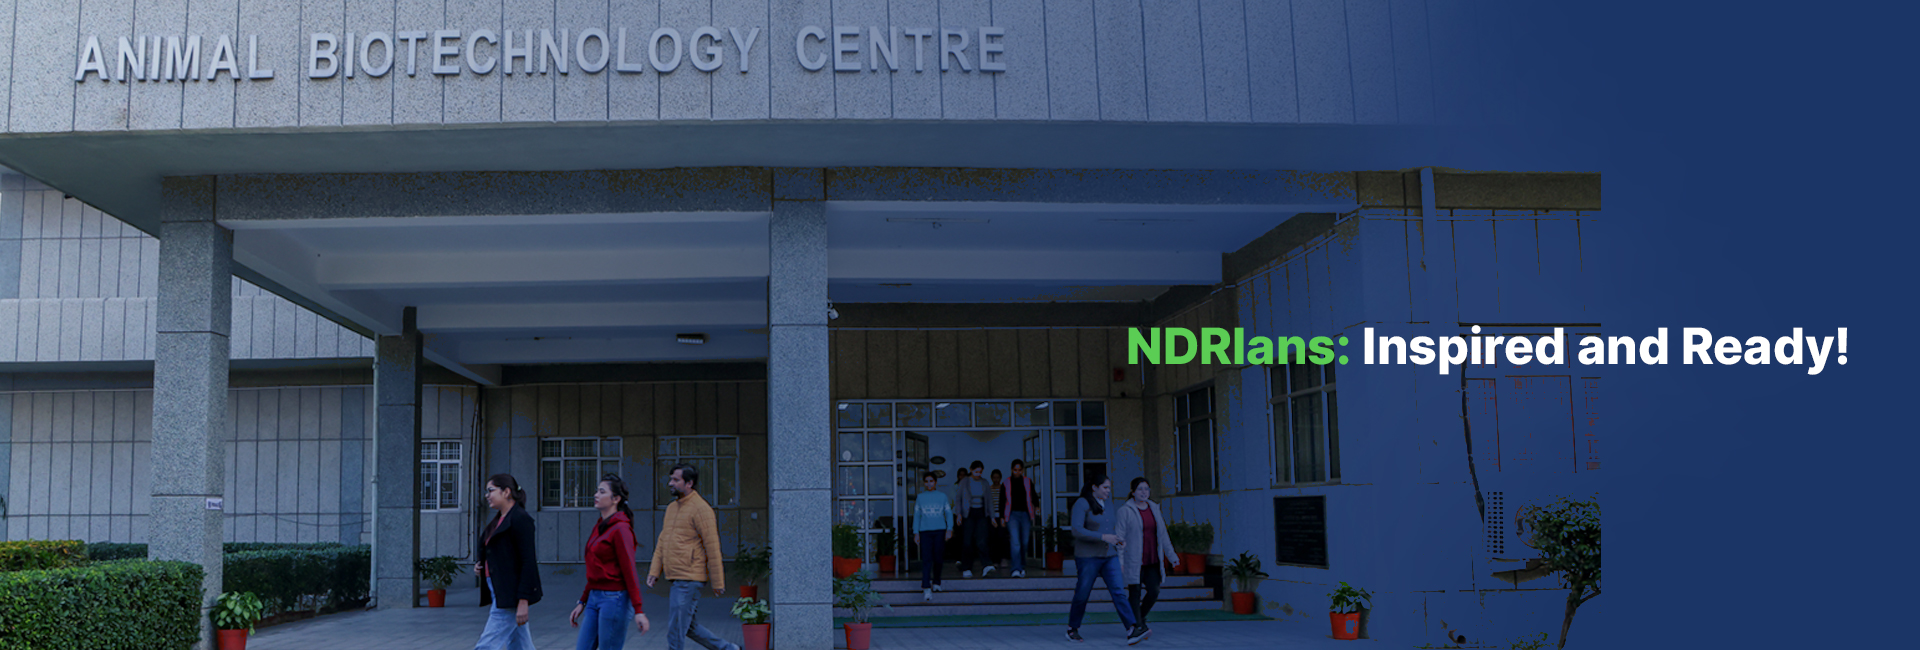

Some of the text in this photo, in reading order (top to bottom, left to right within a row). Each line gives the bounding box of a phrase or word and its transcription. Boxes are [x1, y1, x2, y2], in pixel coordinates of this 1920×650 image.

[75, 25, 1007, 82] ANIMAL BIOTECHNOLOGY CENTRE
